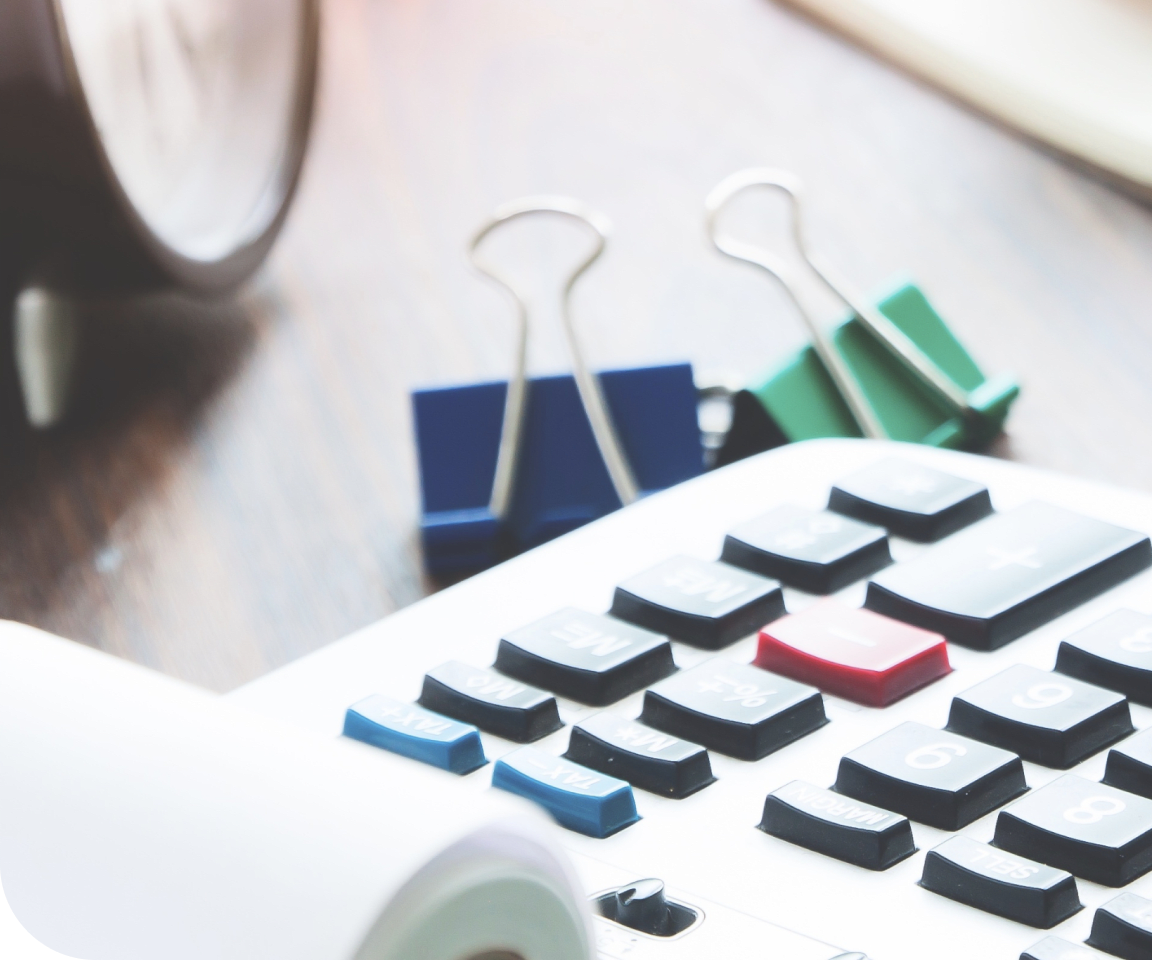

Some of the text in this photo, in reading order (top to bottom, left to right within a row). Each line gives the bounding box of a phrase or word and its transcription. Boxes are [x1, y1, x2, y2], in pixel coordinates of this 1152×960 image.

[1012, 683, 1073, 709] 6
[380, 705, 452, 735] TAX+
[905, 743, 967, 769] 9
[796, 789, 888, 825] MARGIN
[1063, 795, 1126, 824] 8
[969, 848, 1039, 879] SELL
